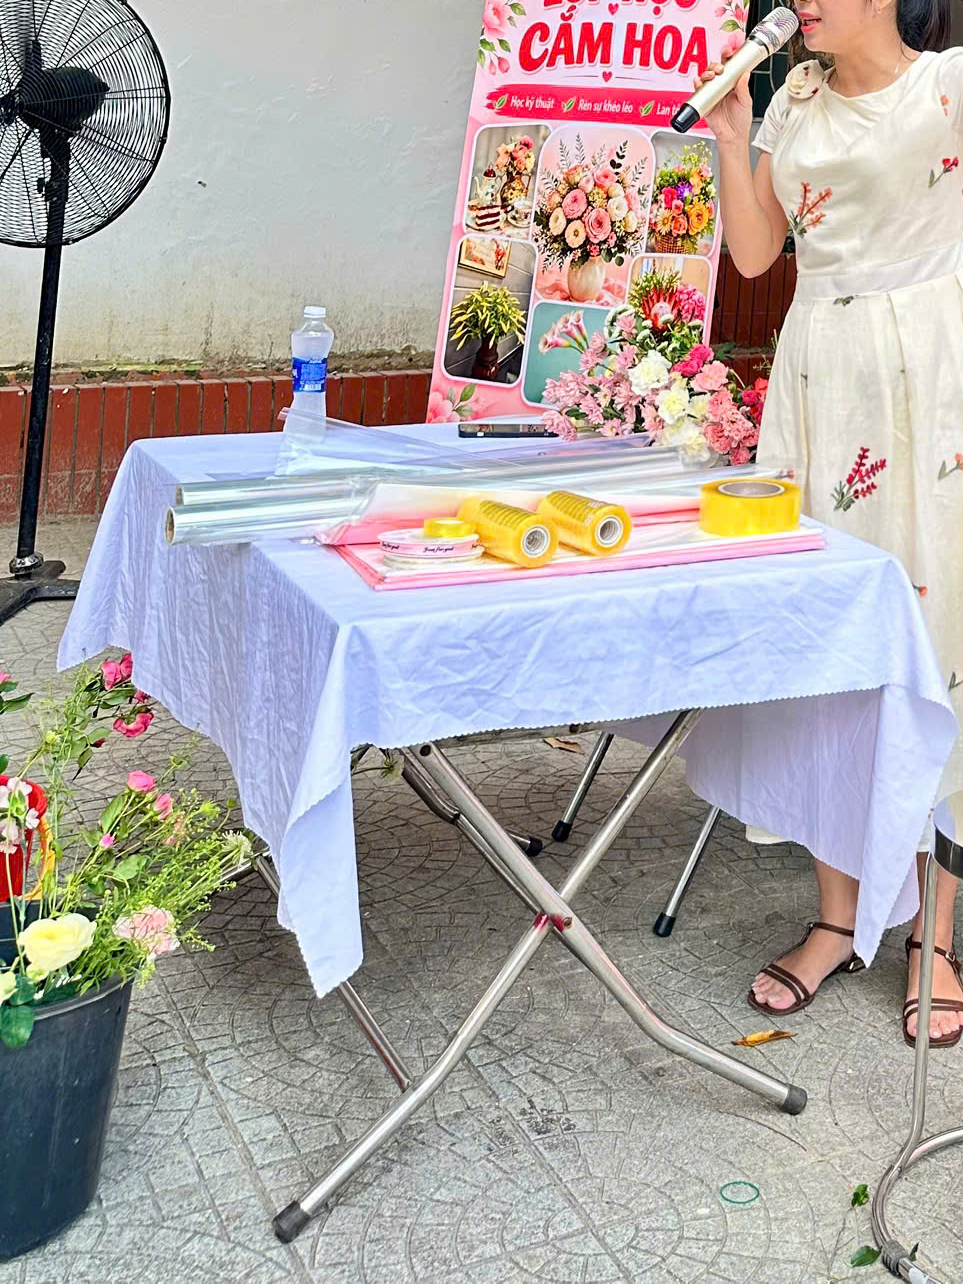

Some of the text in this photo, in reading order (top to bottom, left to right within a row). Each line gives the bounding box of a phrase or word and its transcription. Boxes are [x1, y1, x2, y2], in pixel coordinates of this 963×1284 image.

[518, 4, 709, 78] CẮM HOA
[510, 95, 555, 111] Học kỹ thuật
[657, 103, 671, 115] Lan
